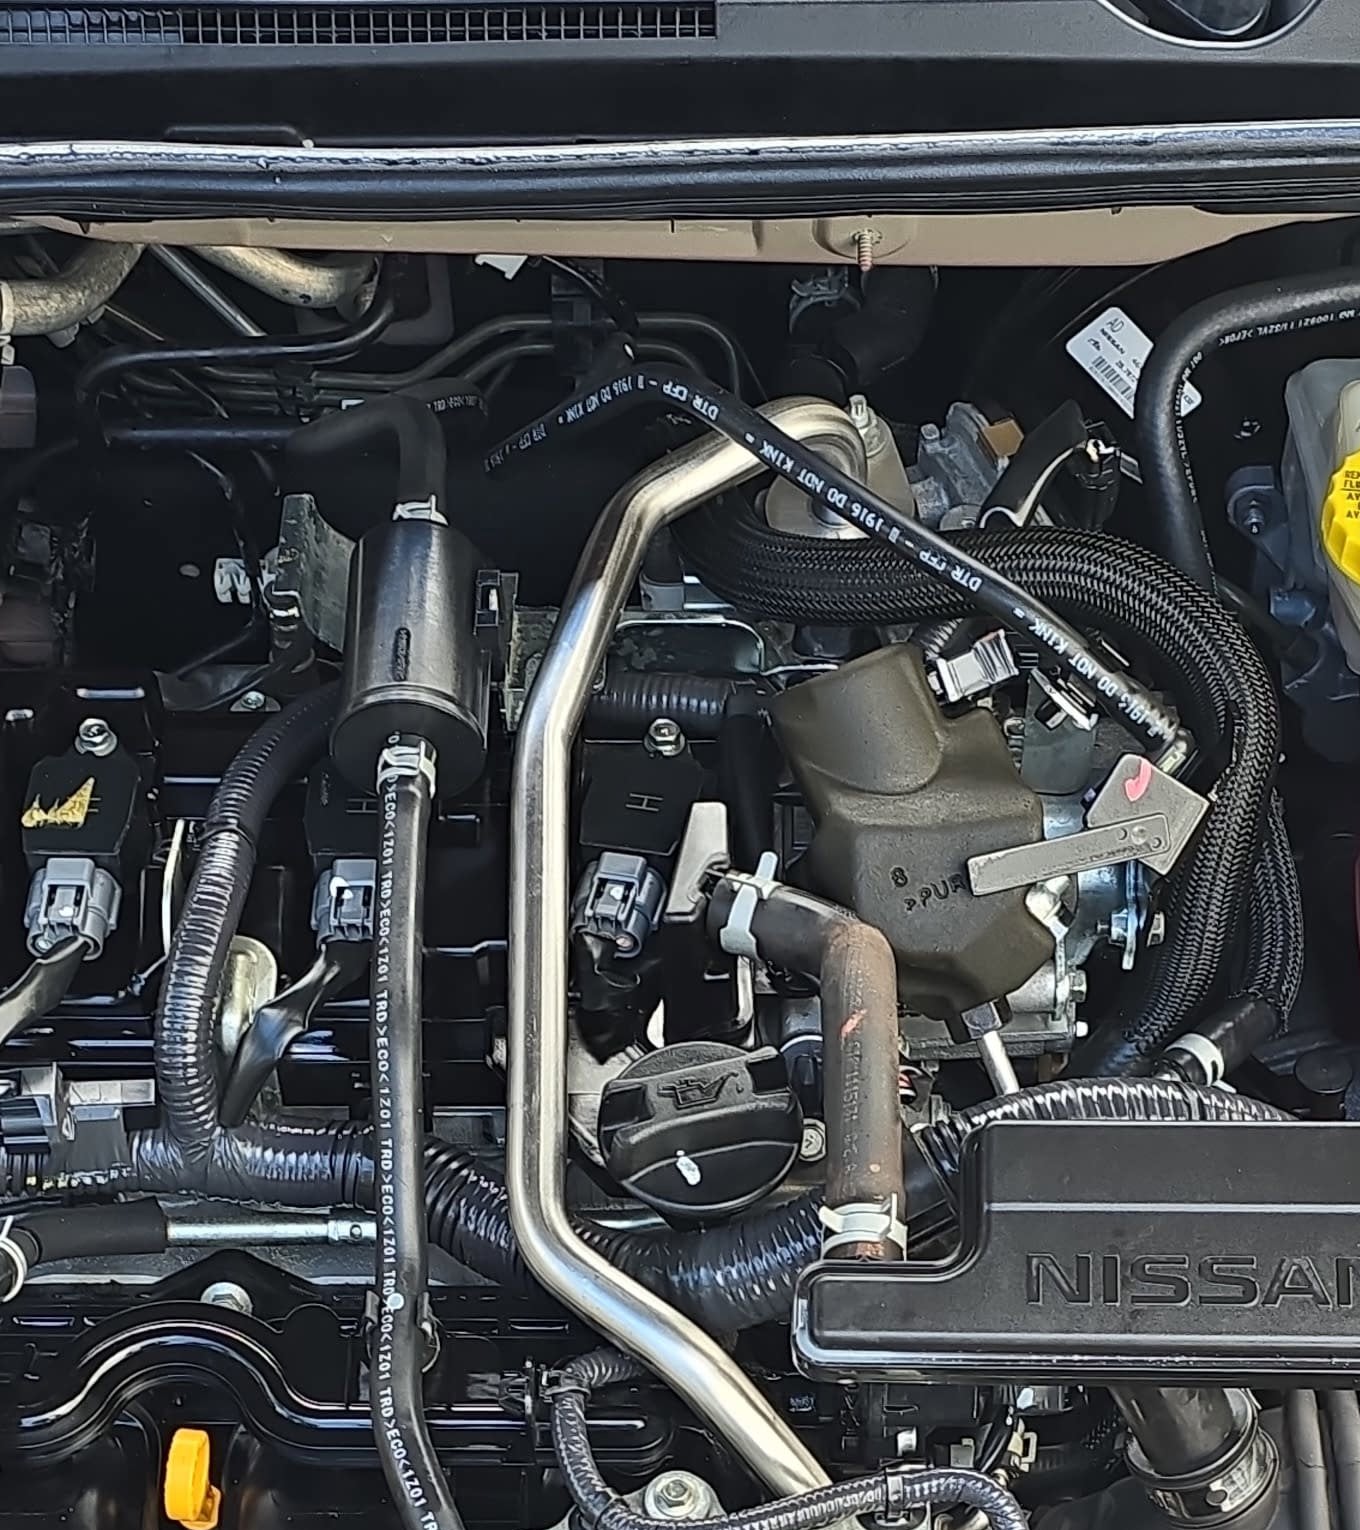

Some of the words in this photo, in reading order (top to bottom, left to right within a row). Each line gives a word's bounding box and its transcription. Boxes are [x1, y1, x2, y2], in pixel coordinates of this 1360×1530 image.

[1106, 318, 1125, 334] AD
[1100, 328, 1126, 354] NISSAN
[687, 396, 721, 422] DTR
[758, 438, 794, 469] KINK
[795, 466, 827, 495] NOT
[826, 481, 852, 509] DO
[952, 560, 981, 593] DTR
[1029, 621, 1064, 655] KINK
[1066, 647, 1095, 681] NOT
[1095, 674, 1119, 699] DO
